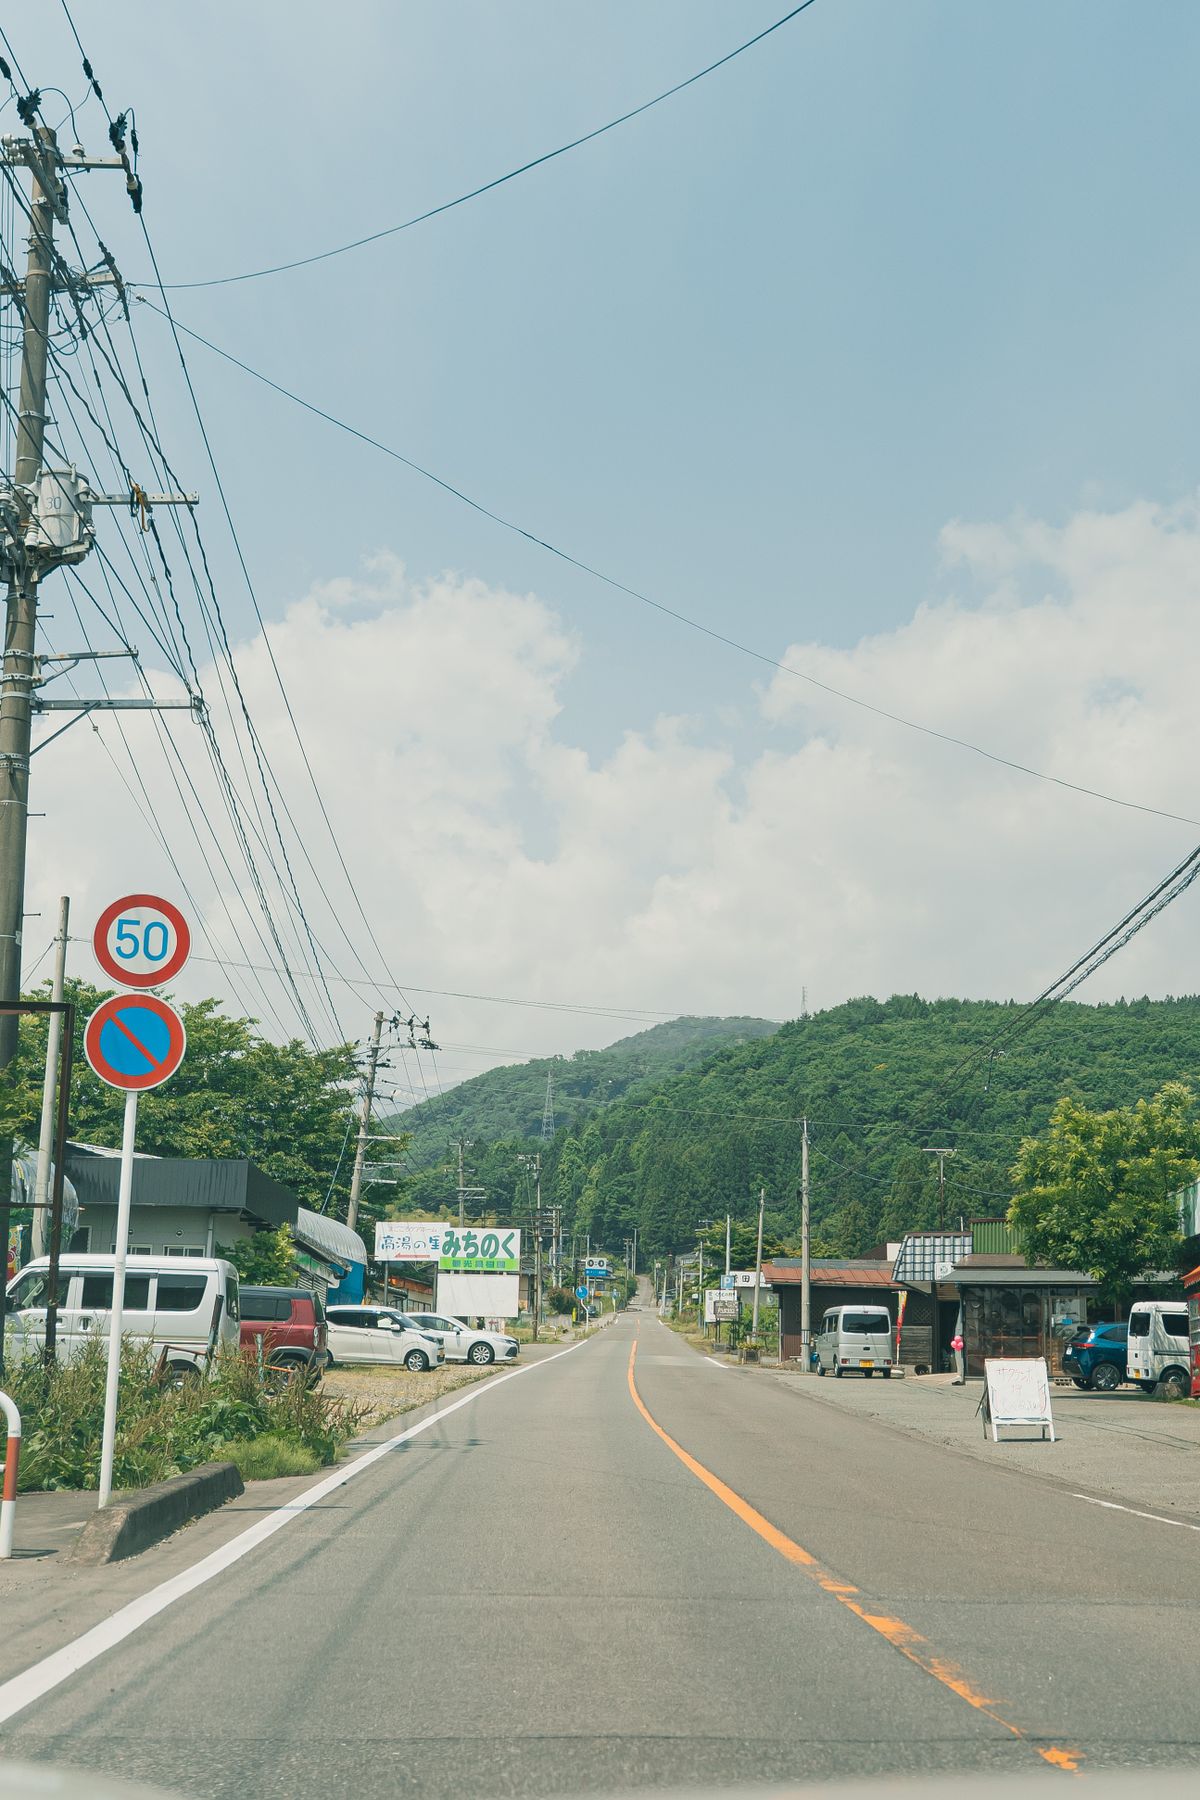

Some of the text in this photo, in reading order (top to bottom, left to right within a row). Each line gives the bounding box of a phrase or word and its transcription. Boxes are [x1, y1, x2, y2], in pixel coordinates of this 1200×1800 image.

[47, 497, 62, 510] 30
[115, 918, 169, 962] 50
[441, 1230, 515, 1259] みちのく
